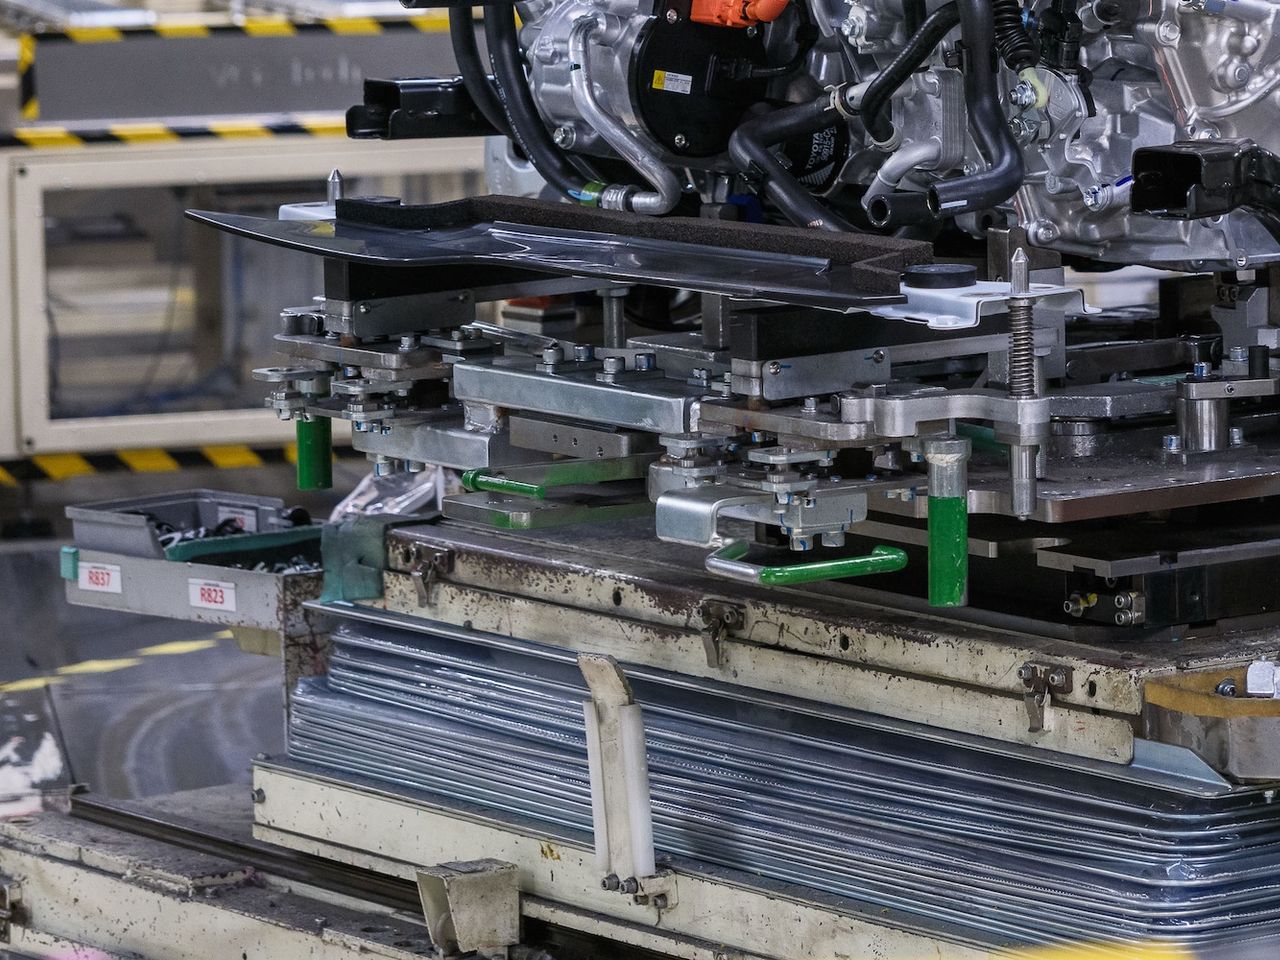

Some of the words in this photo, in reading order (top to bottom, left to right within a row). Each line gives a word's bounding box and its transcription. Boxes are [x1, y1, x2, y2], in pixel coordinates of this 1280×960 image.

[806, 132, 820, 169] TOYOTA
[88, 570, 111, 587] R837
[200, 586, 225, 605] R823
